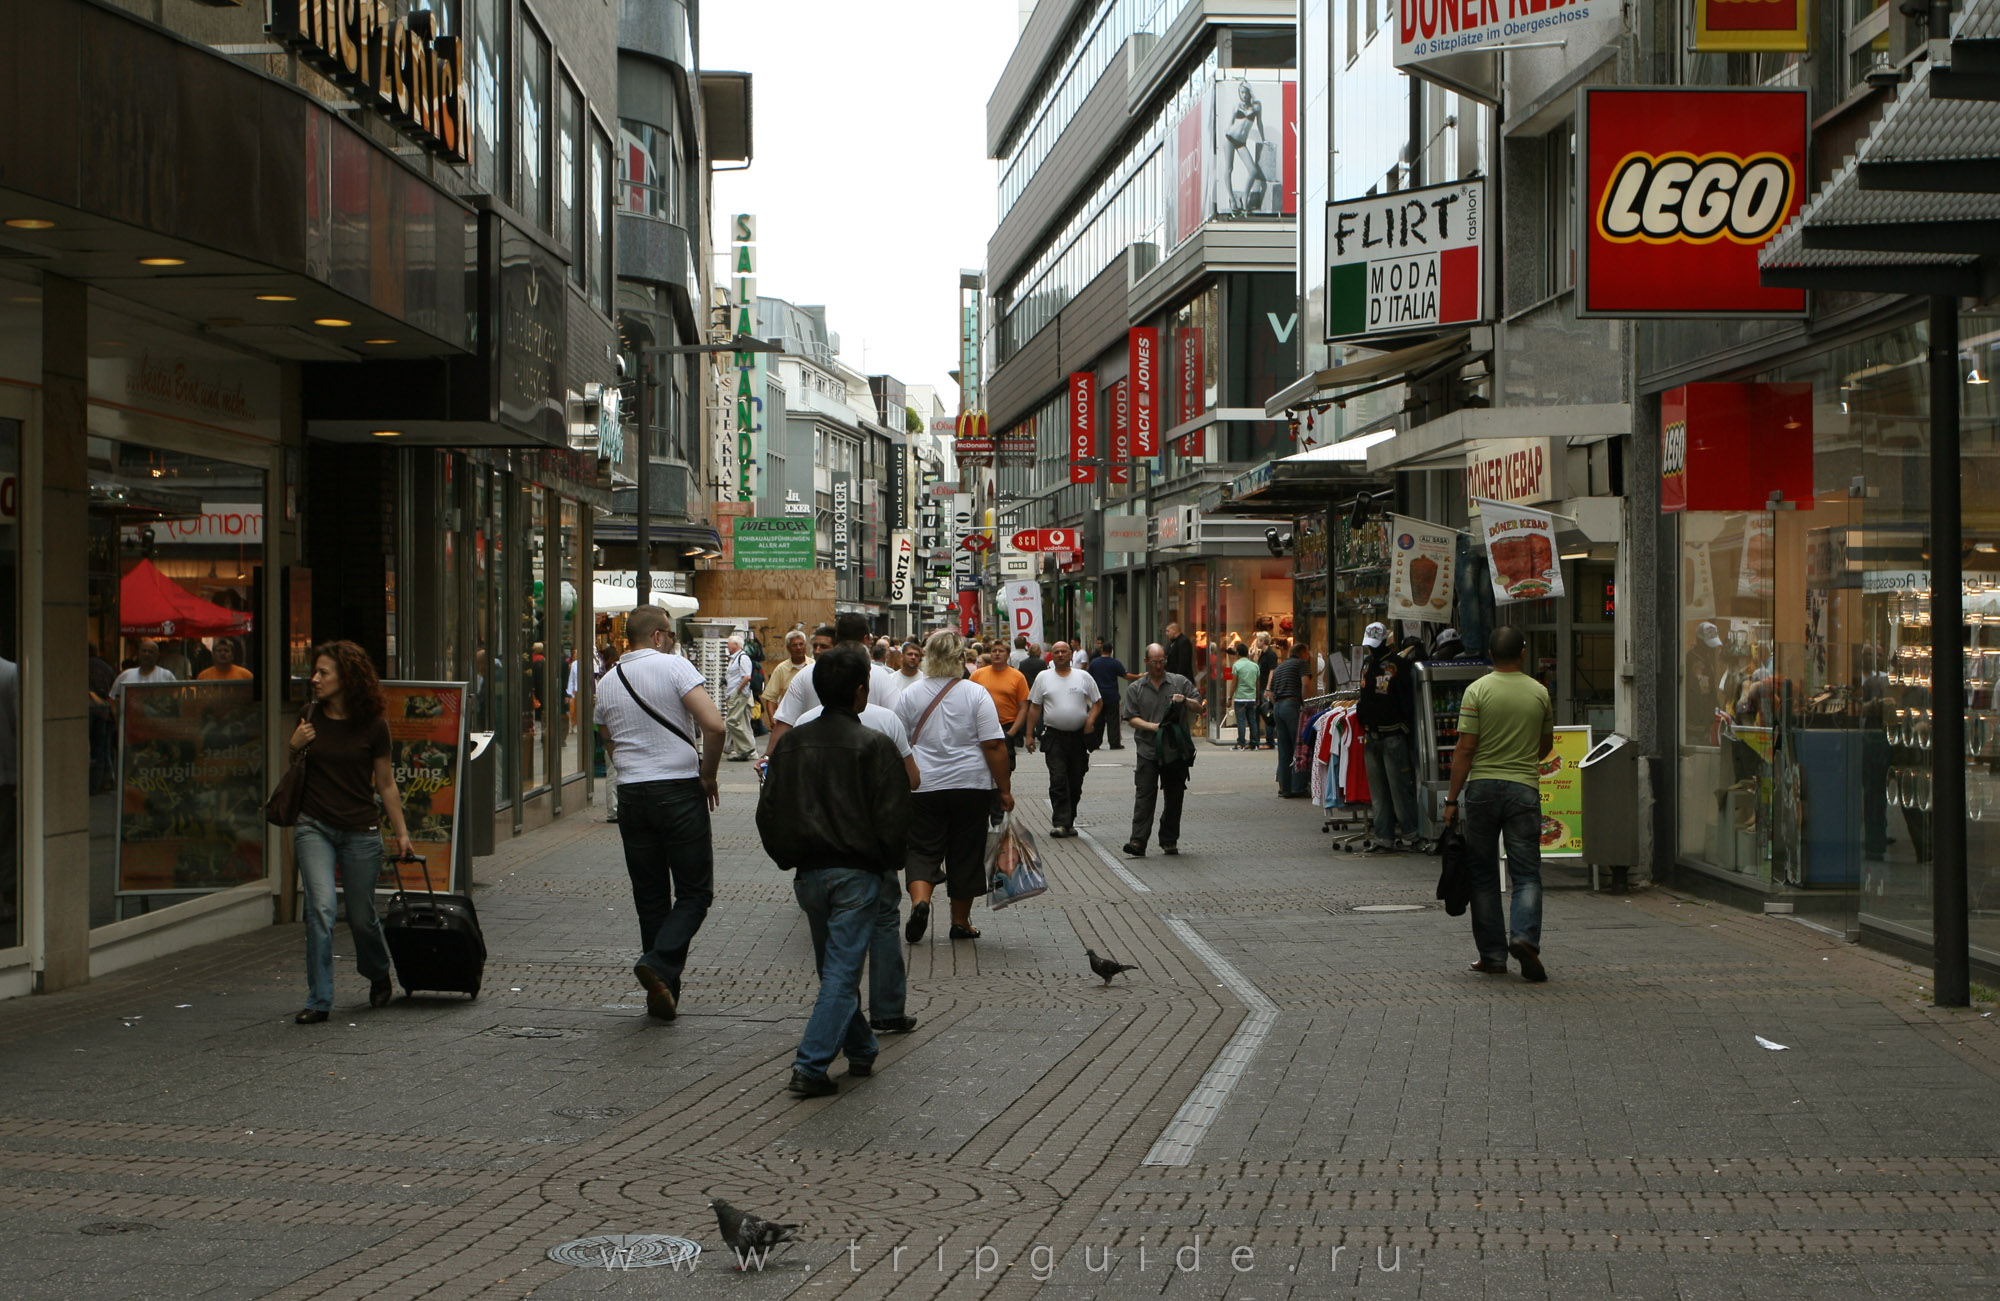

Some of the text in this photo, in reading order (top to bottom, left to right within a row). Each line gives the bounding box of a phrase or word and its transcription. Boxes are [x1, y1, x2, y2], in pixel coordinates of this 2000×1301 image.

[1413, 43, 1427, 56] 40
[1430, 32, 1483, 54] Sitzplätze
[1486, 28, 1500, 41] im
[1503, 7, 1590, 37] Obergeschoss
[1334, 193, 1460, 256] FLIRT
[1467, 189, 1477, 242] fashion
[1603, 156, 1790, 240] LEGO
[1371, 259, 1438, 294] MODA
[735, 213, 756, 502] SALAMANDE
[1139, 337, 1150, 391] JONES
[956, 441, 993, 449] McDonald's
[1077, 378, 1088, 480] VRO MODA
[1139, 407, 1150, 452] JACK
[1663, 423, 1686, 476] LEGO
[1468, 445, 1543, 509] DÖNER KEBAP
[740, 520, 809, 531] WIELOCH
[834, 480, 848, 544] BECKER
[900, 538, 912, 552] 17
[955, 511, 971, 576] ANGO
